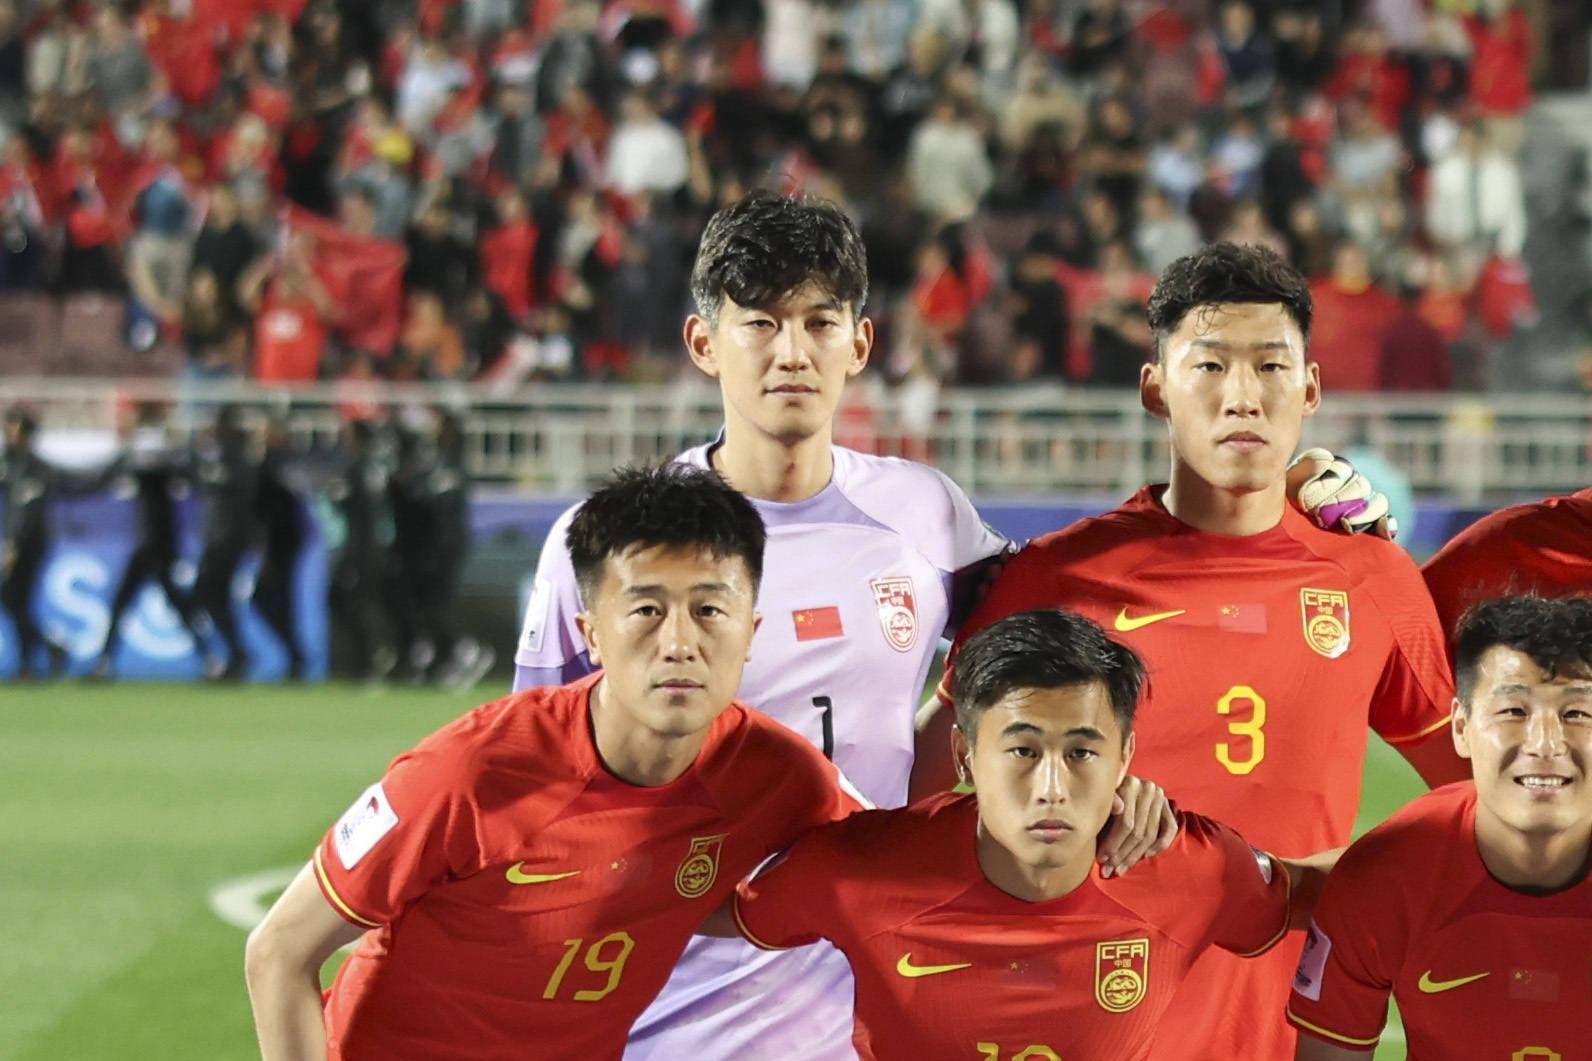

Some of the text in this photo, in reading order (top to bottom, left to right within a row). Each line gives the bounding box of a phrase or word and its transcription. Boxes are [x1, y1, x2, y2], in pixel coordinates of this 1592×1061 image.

[1304, 592, 1344, 608] CFA
[812, 696, 834, 760] 1
[1215, 685, 1266, 775] 3
[542, 931, 636, 1002] 19
[1101, 944, 1144, 960] CFA
